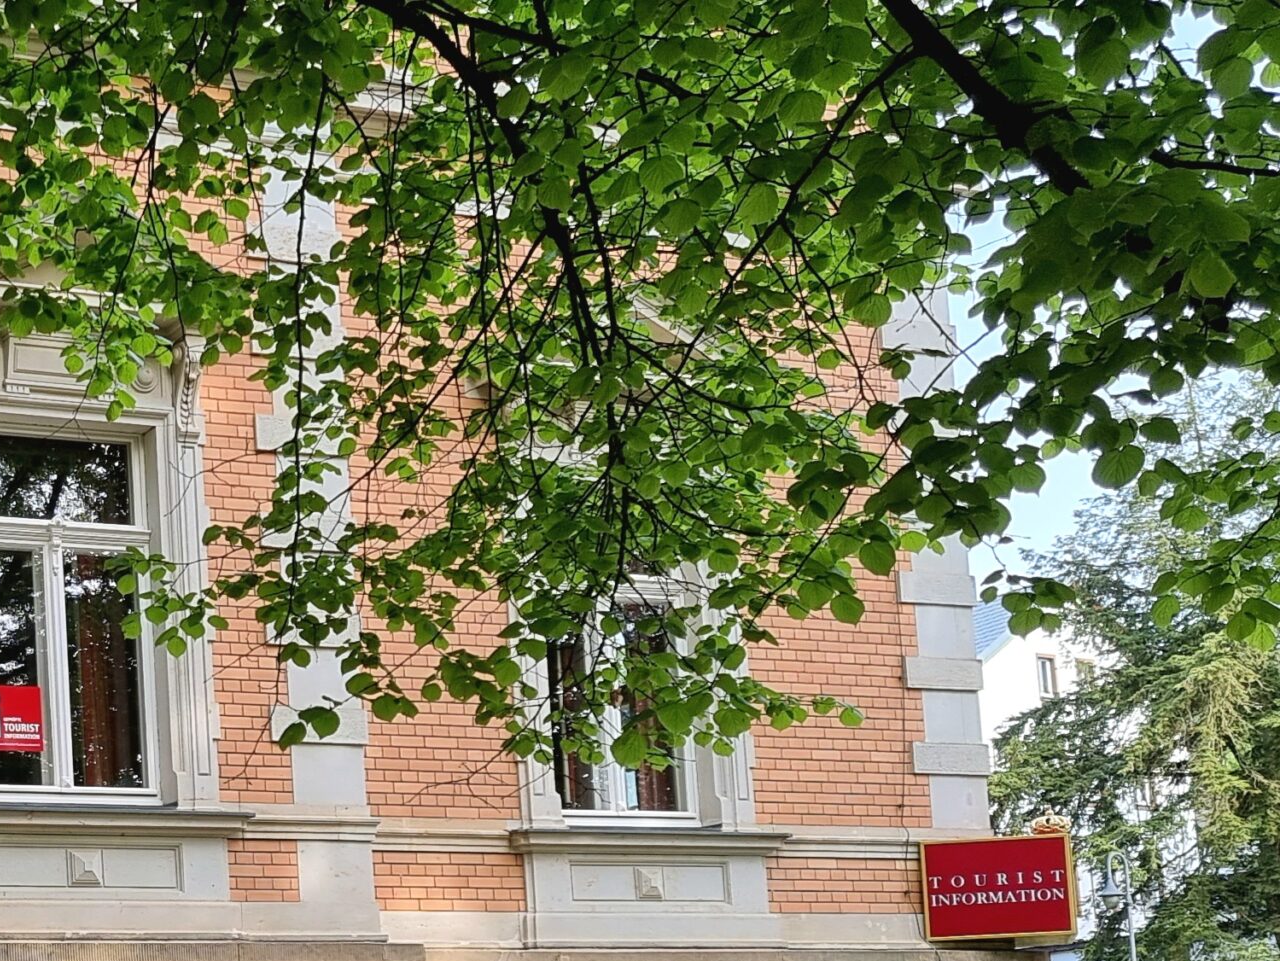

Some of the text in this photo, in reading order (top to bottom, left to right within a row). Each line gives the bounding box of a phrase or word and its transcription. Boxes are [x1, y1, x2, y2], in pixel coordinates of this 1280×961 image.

[3, 723, 40, 733] TOURIST
[929, 869, 1065, 889] TOURIST
[931, 888, 1065, 907] INFORMATION
